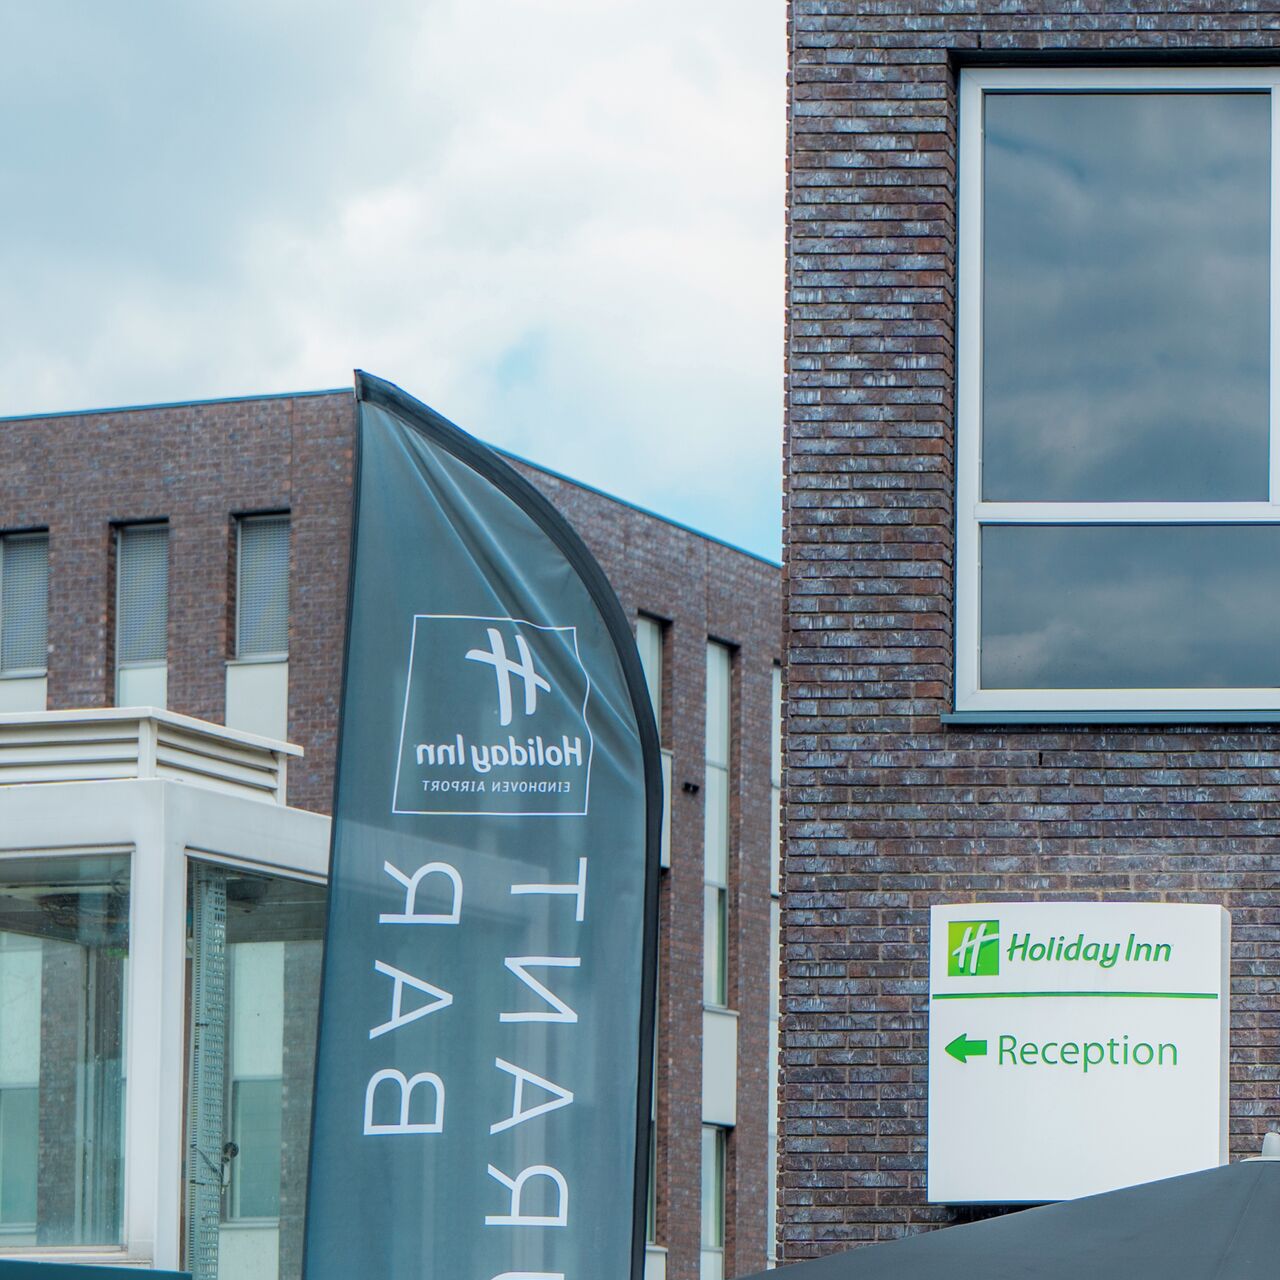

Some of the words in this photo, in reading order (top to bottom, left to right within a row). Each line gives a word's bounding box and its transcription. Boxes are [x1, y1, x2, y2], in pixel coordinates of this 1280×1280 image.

[1007, 933, 1120, 968] Holiday
[1126, 933, 1172, 962] Inn
[998, 1035, 1178, 1073] Reception
